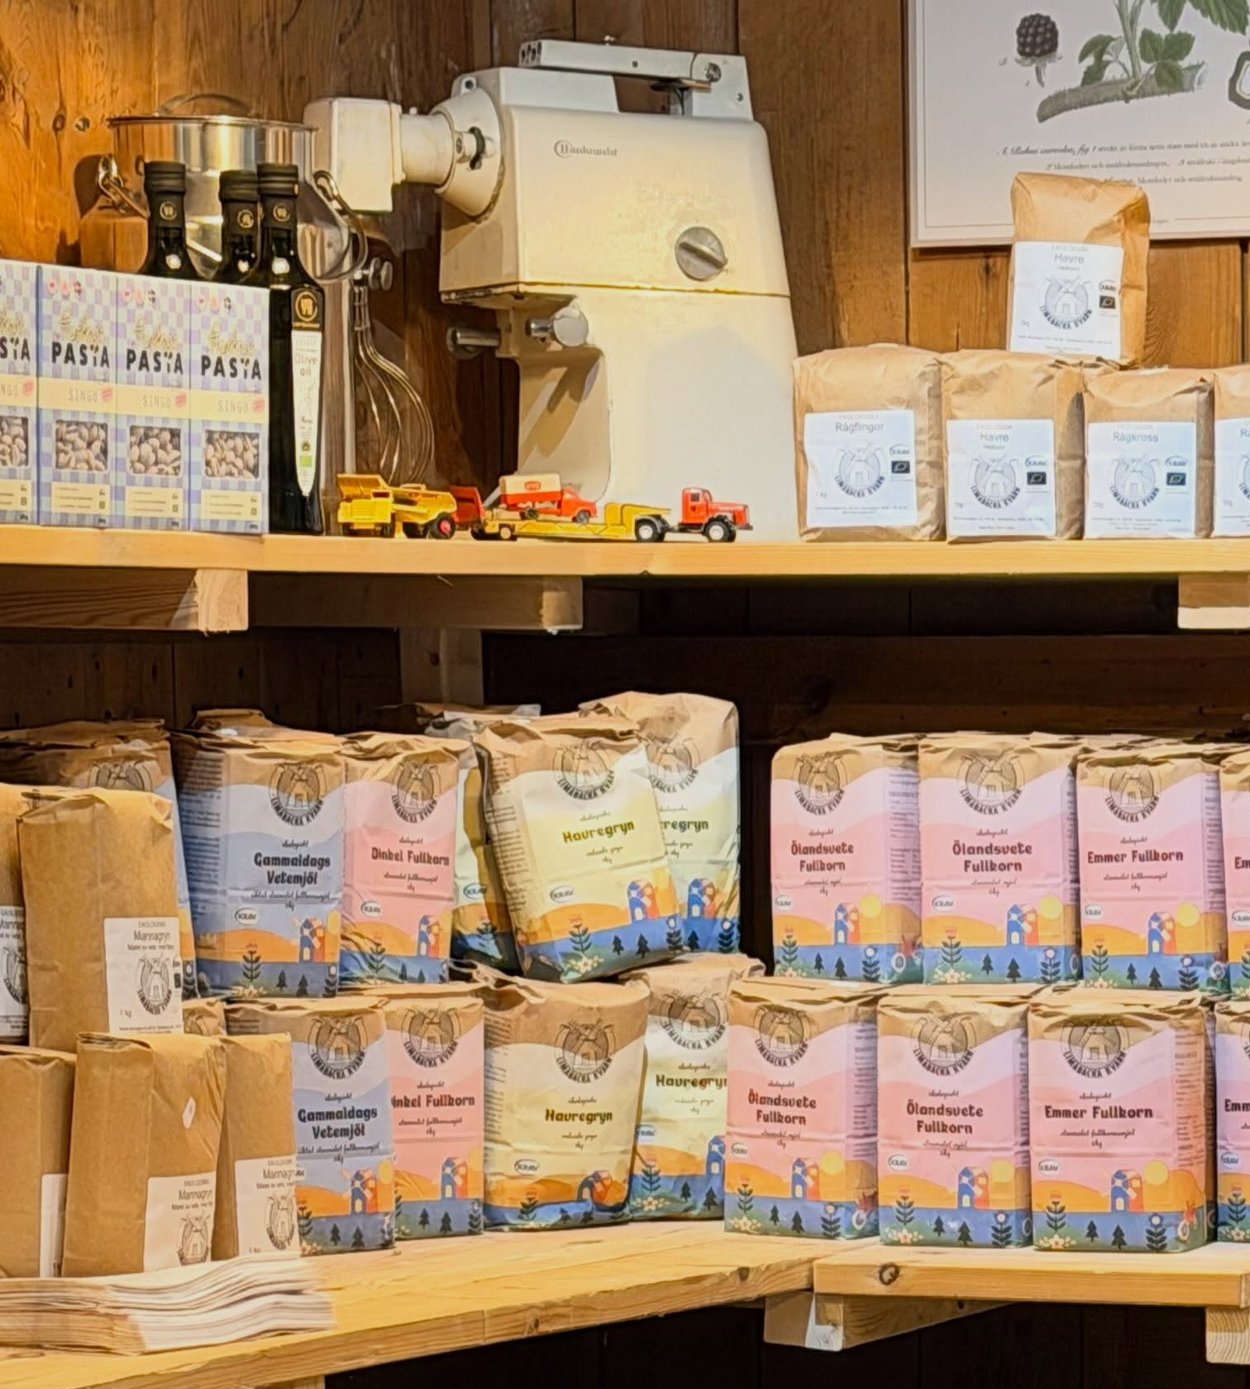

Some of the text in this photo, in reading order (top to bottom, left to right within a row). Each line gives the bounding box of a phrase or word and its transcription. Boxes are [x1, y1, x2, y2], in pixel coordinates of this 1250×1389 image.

[1054, 252, 1085, 265] Havre
[0, 337, 31, 362] STA
[51, 341, 110, 370] PASTA
[125, 348, 184, 375] PASTA
[200, 354, 262, 381] PASTA
[0, 384, 19, 398] NGO
[835, 422, 885, 434] Rågflingor
[980, 432, 1009, 443] Havre
[1112, 432, 1160, 443] Rågkross
[562, 820, 636, 844] Havregryn
[660, 818, 709, 833] regryn
[791, 840, 854, 856] Ölandsvete
[952, 839, 1032, 856] Ölandsvete
[254, 852, 331, 871] Gammaldags
[371, 847, 450, 867] Dinkel Fullkorn
[1087, 849, 1184, 864] Emmer Fullkorn
[800, 860, 846, 873] Fullkorn
[964, 860, 1023, 873] Fullkorn
[267, 870, 318, 887] Vetemjöl
[391, 1094, 476, 1109] inkel Fullkorn
[748, 1089, 817, 1109] Ölandsvete
[298, 1106, 378, 1123] Gammaldags
[545, 1108, 613, 1125] Havregryn
[906, 1099, 984, 1118] Ölandsvete
[1044, 1105, 1153, 1120] Emmer Fullkorn
[756, 1109, 807, 1126] Fullkorn
[312, 1123, 366, 1140] Vetemjöl
[917, 1120, 973, 1135] Fullkorn
